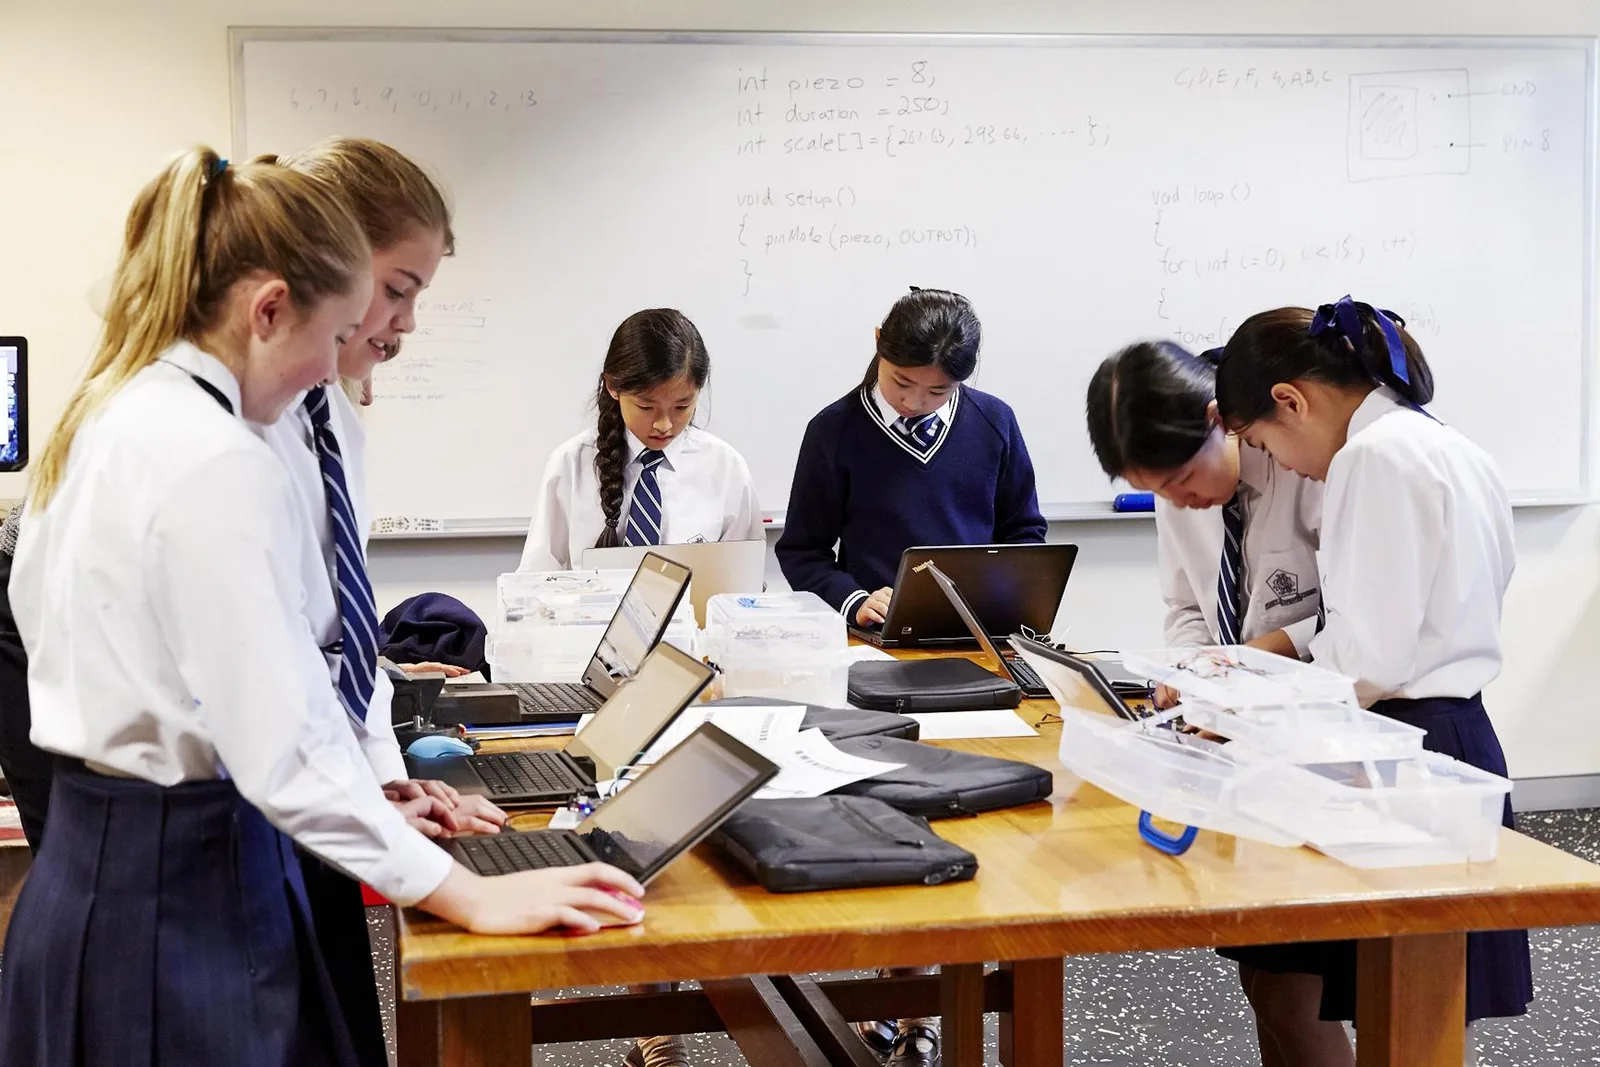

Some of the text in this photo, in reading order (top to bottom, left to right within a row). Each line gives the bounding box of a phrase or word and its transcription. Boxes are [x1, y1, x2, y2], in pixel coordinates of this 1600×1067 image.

[738, 67, 768, 94] int
[788, 78, 864, 100] piezo
[911, 60, 935, 88] 8;
[738, 102, 764, 126] int
[786, 103, 859, 123] duration
[738, 134, 767, 155] int
[738, 187, 773, 206] void
